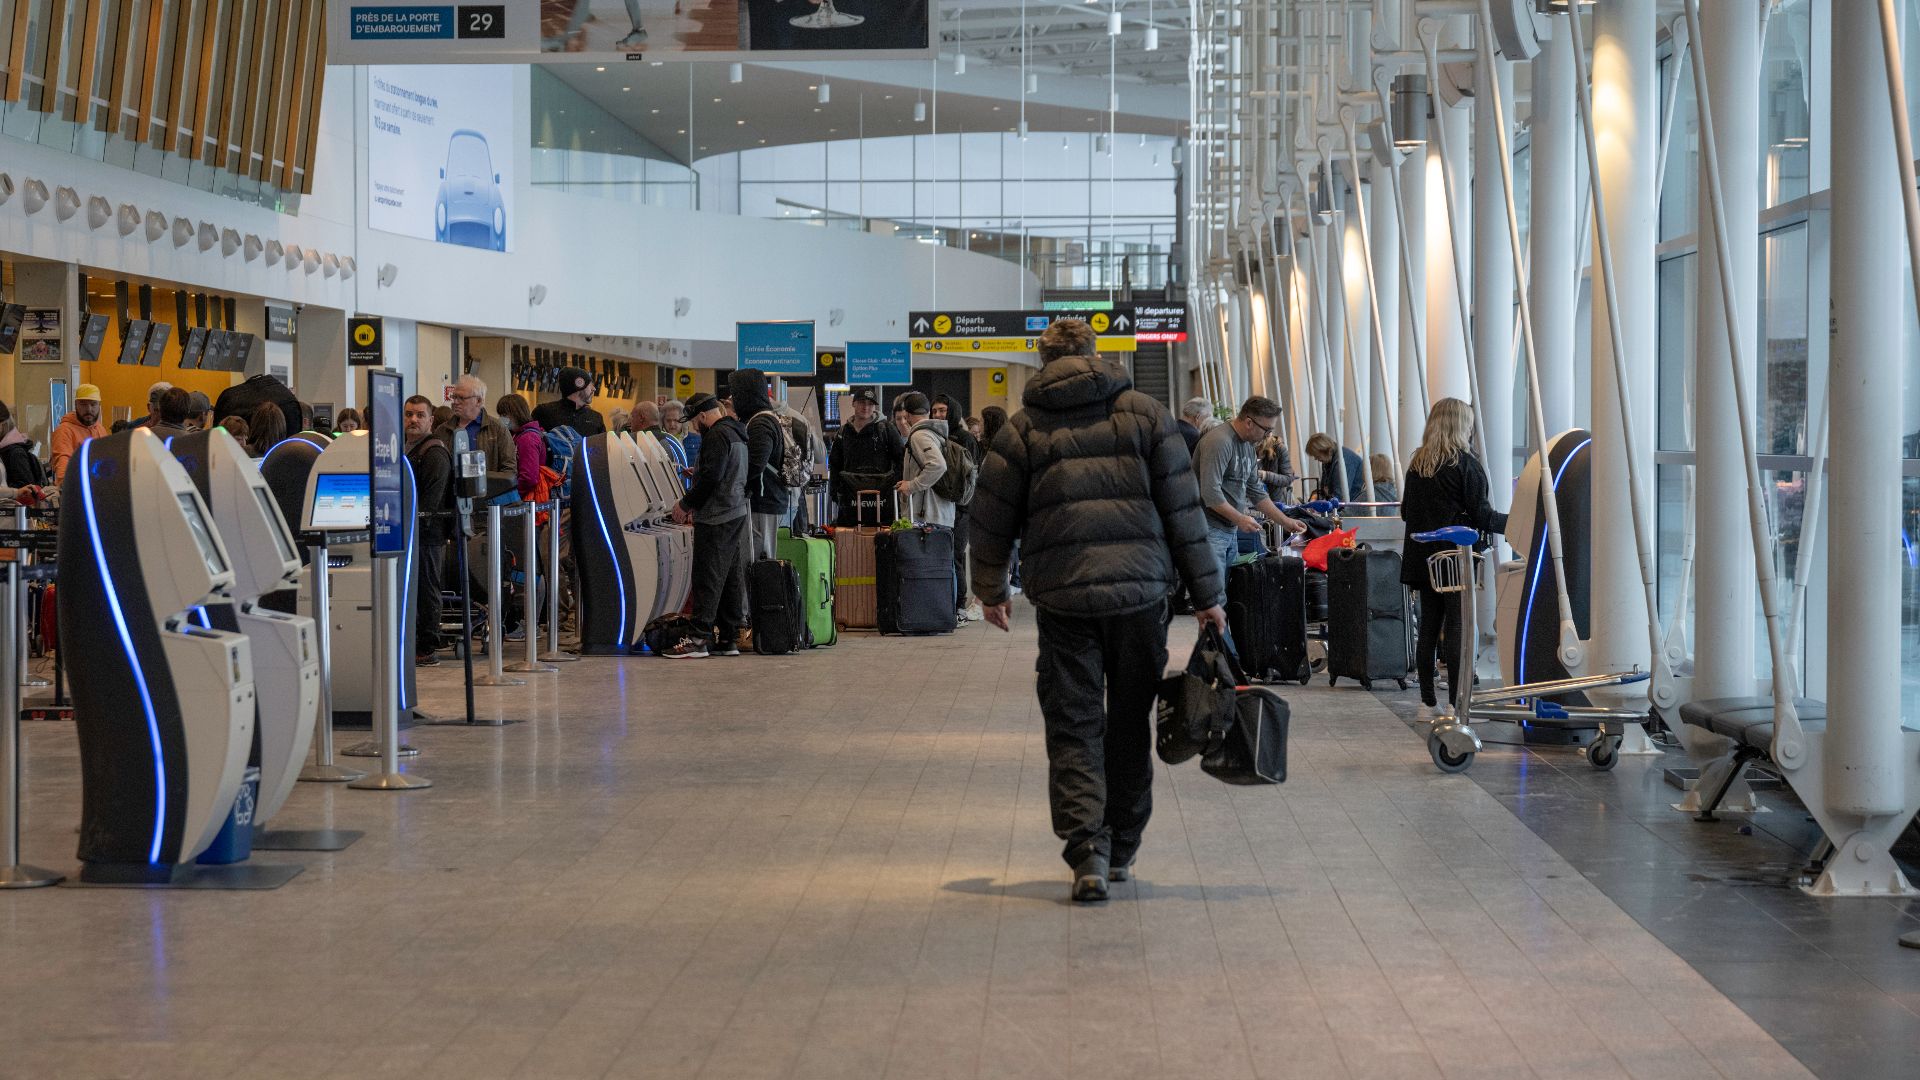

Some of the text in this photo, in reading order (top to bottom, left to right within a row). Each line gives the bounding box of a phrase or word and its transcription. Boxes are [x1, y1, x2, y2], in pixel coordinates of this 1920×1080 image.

[356, 12, 439, 22] PRÈS DE LA PORTE
[470, 13, 493, 31] 29
[356, 24, 442, 33] D'EMBARQUEMENT
[1144, 307, 1184, 317] departures
[955, 315, 984, 325] Départs
[956, 325, 996, 334] Departures
[765, 344, 796, 352] Économie
